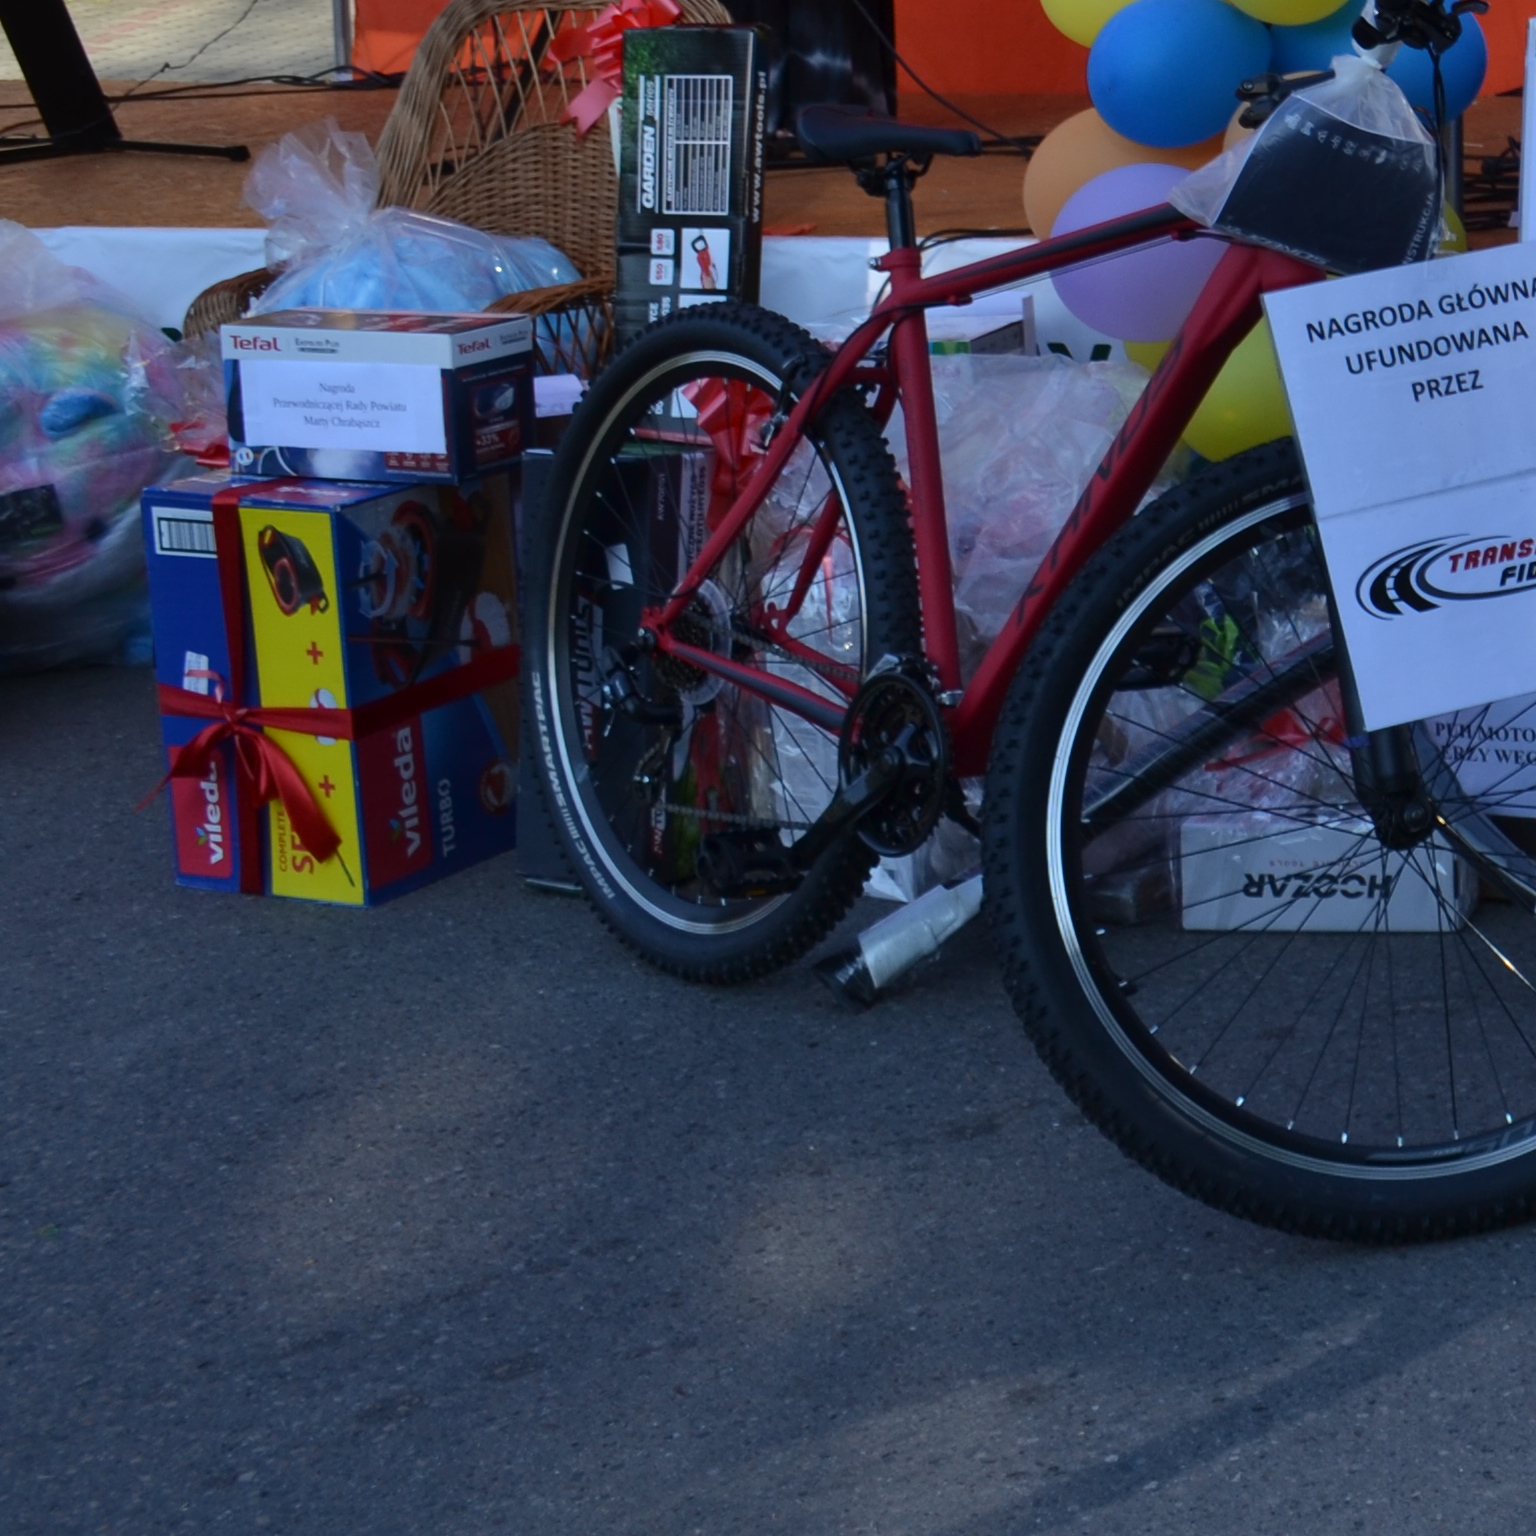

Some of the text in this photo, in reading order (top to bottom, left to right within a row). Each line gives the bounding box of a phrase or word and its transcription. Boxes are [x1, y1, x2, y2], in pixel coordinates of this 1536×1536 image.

[641, 124, 656, 209] GARDEN
[751, 70, 768, 224] www.awtools.pl
[229, 335, 282, 352] Tefal
[457, 337, 491, 355] Tefal
[1305, 297, 1434, 344] NAGRODA
[1345, 319, 1530, 376] UFUNDOWANA
[319, 382, 356, 396] Nagroda
[345, 399, 369, 413] Rady
[1411, 368, 1484, 403] PRZEZ
[394, 726, 422, 857] vileda
[436, 778, 457, 857] TURBO
[278, 811, 288, 874] COMPLETE
